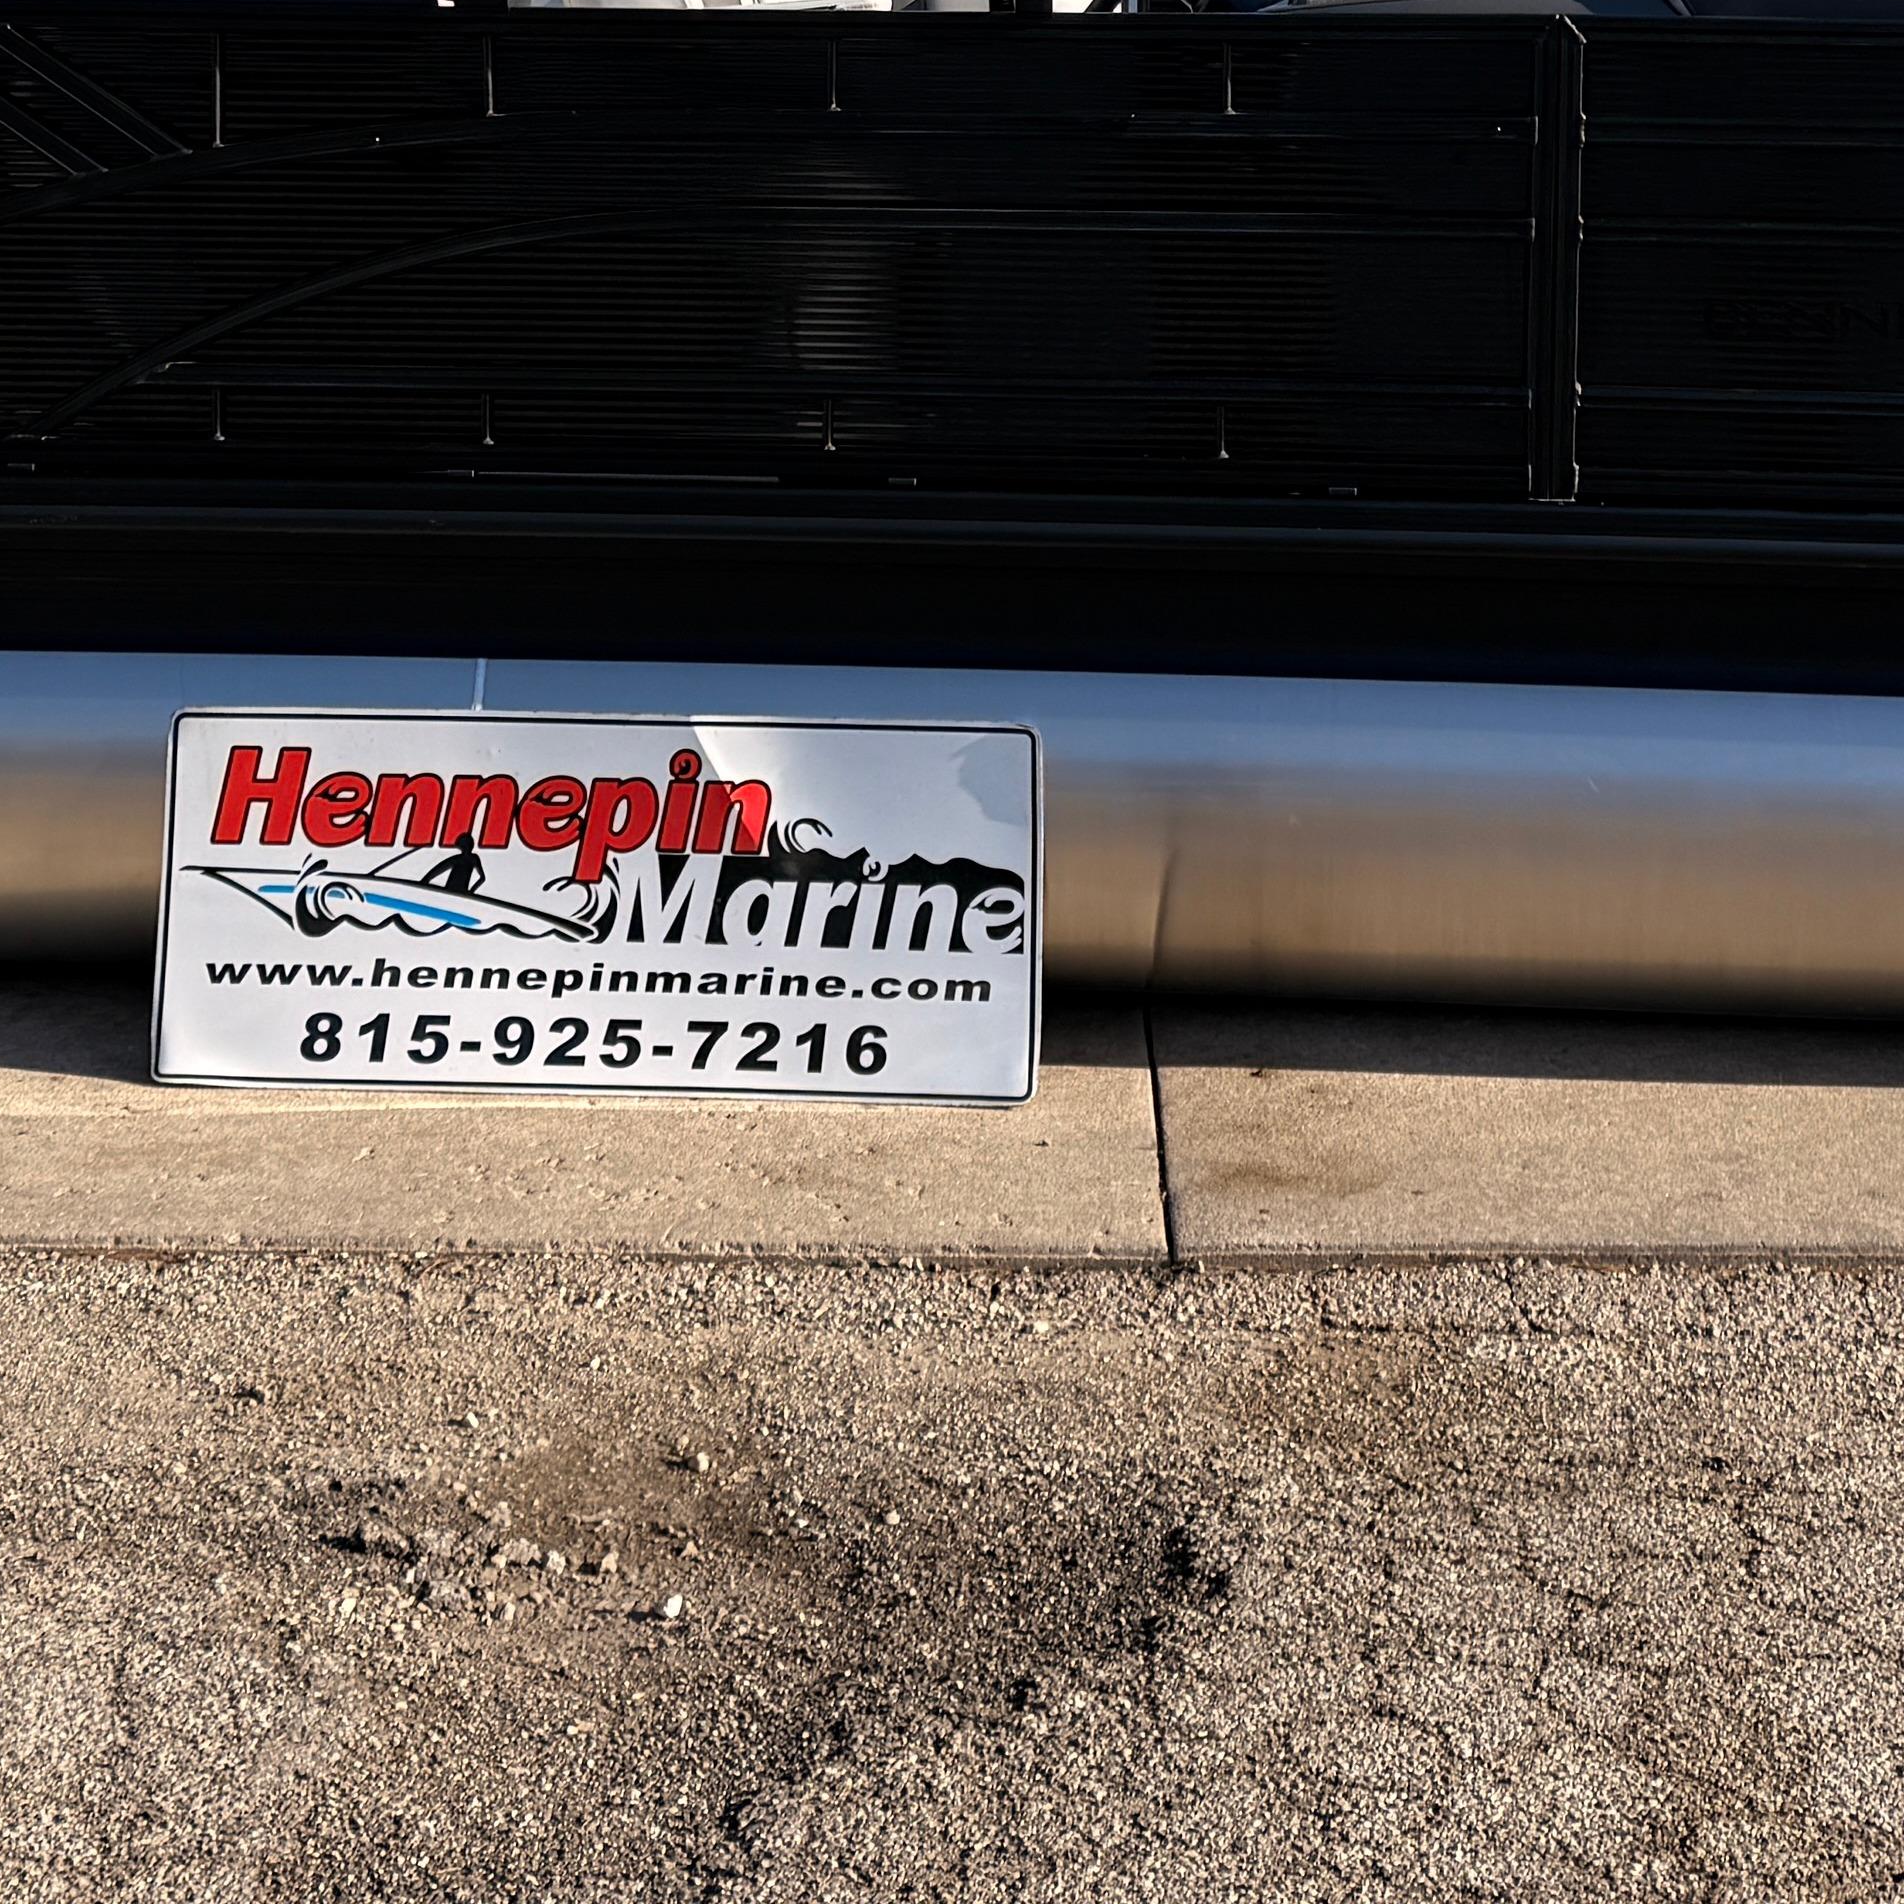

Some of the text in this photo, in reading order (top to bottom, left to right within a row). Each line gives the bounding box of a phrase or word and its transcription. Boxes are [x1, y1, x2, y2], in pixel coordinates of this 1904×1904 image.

[210, 744, 772, 882] Hennepin
[620, 853, 1025, 954] Marine
[206, 958, 991, 1003] www.hennepinmarine.com
[299, 1011, 889, 1077] 815-925-7216
